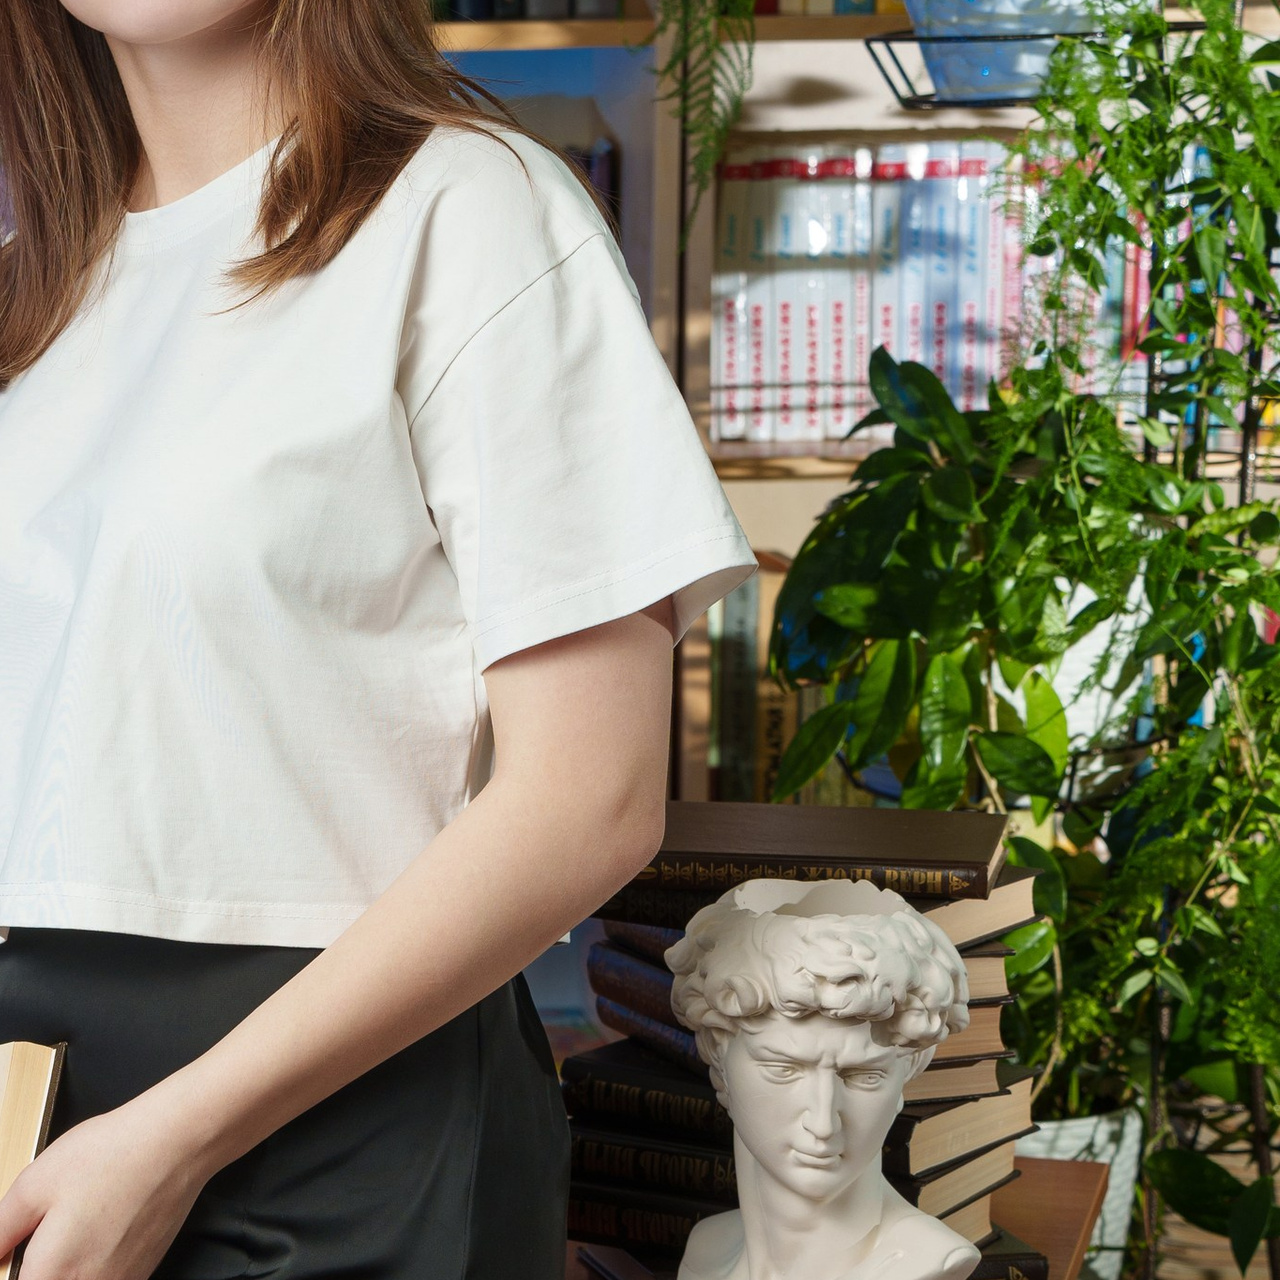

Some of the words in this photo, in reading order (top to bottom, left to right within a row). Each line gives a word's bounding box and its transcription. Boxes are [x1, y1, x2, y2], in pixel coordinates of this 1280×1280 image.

[884, 868, 944, 894] ВЕРН
[583, 1140, 635, 1179] ВЕРН
[638, 1150, 709, 1191] ЖЮЛЬ
